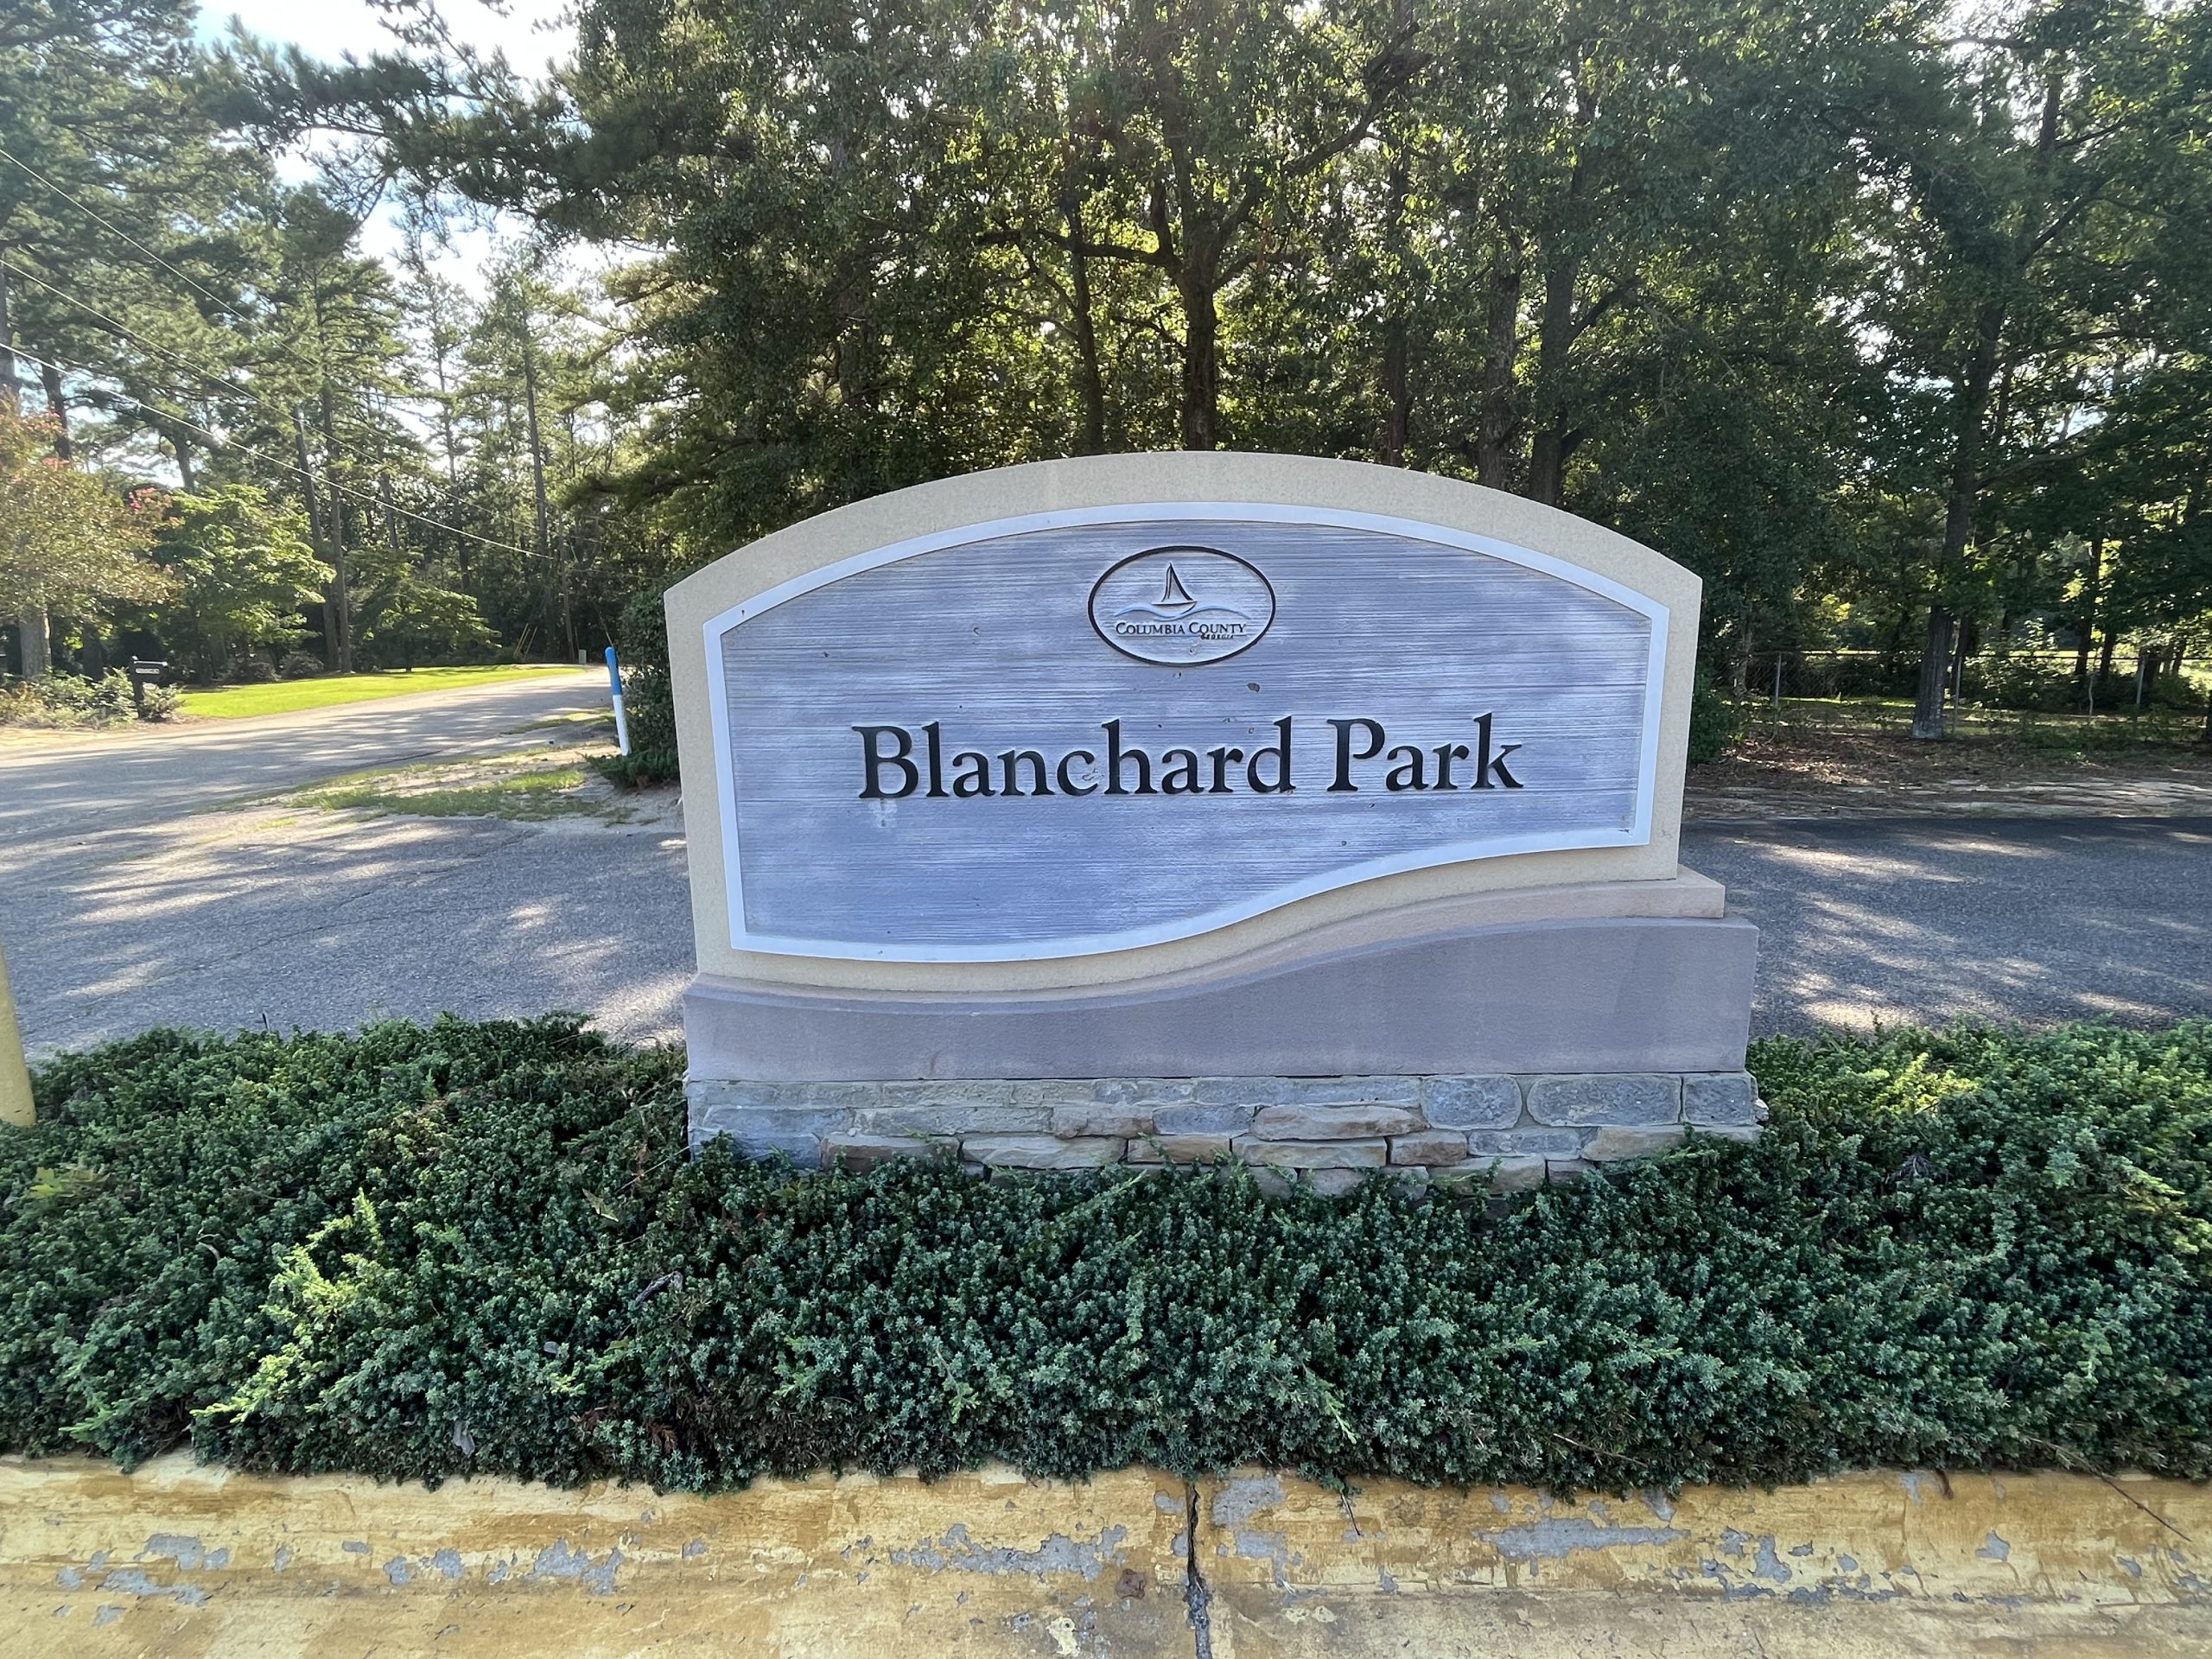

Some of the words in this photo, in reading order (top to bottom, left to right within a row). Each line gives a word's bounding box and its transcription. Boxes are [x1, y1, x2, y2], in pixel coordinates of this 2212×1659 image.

[1116, 622, 1185, 634] COLUMBIA
[1188, 622, 1246, 634] COUNTY
[852, 715, 1296, 798] Blanchard
[1326, 712, 1524, 791] Park
